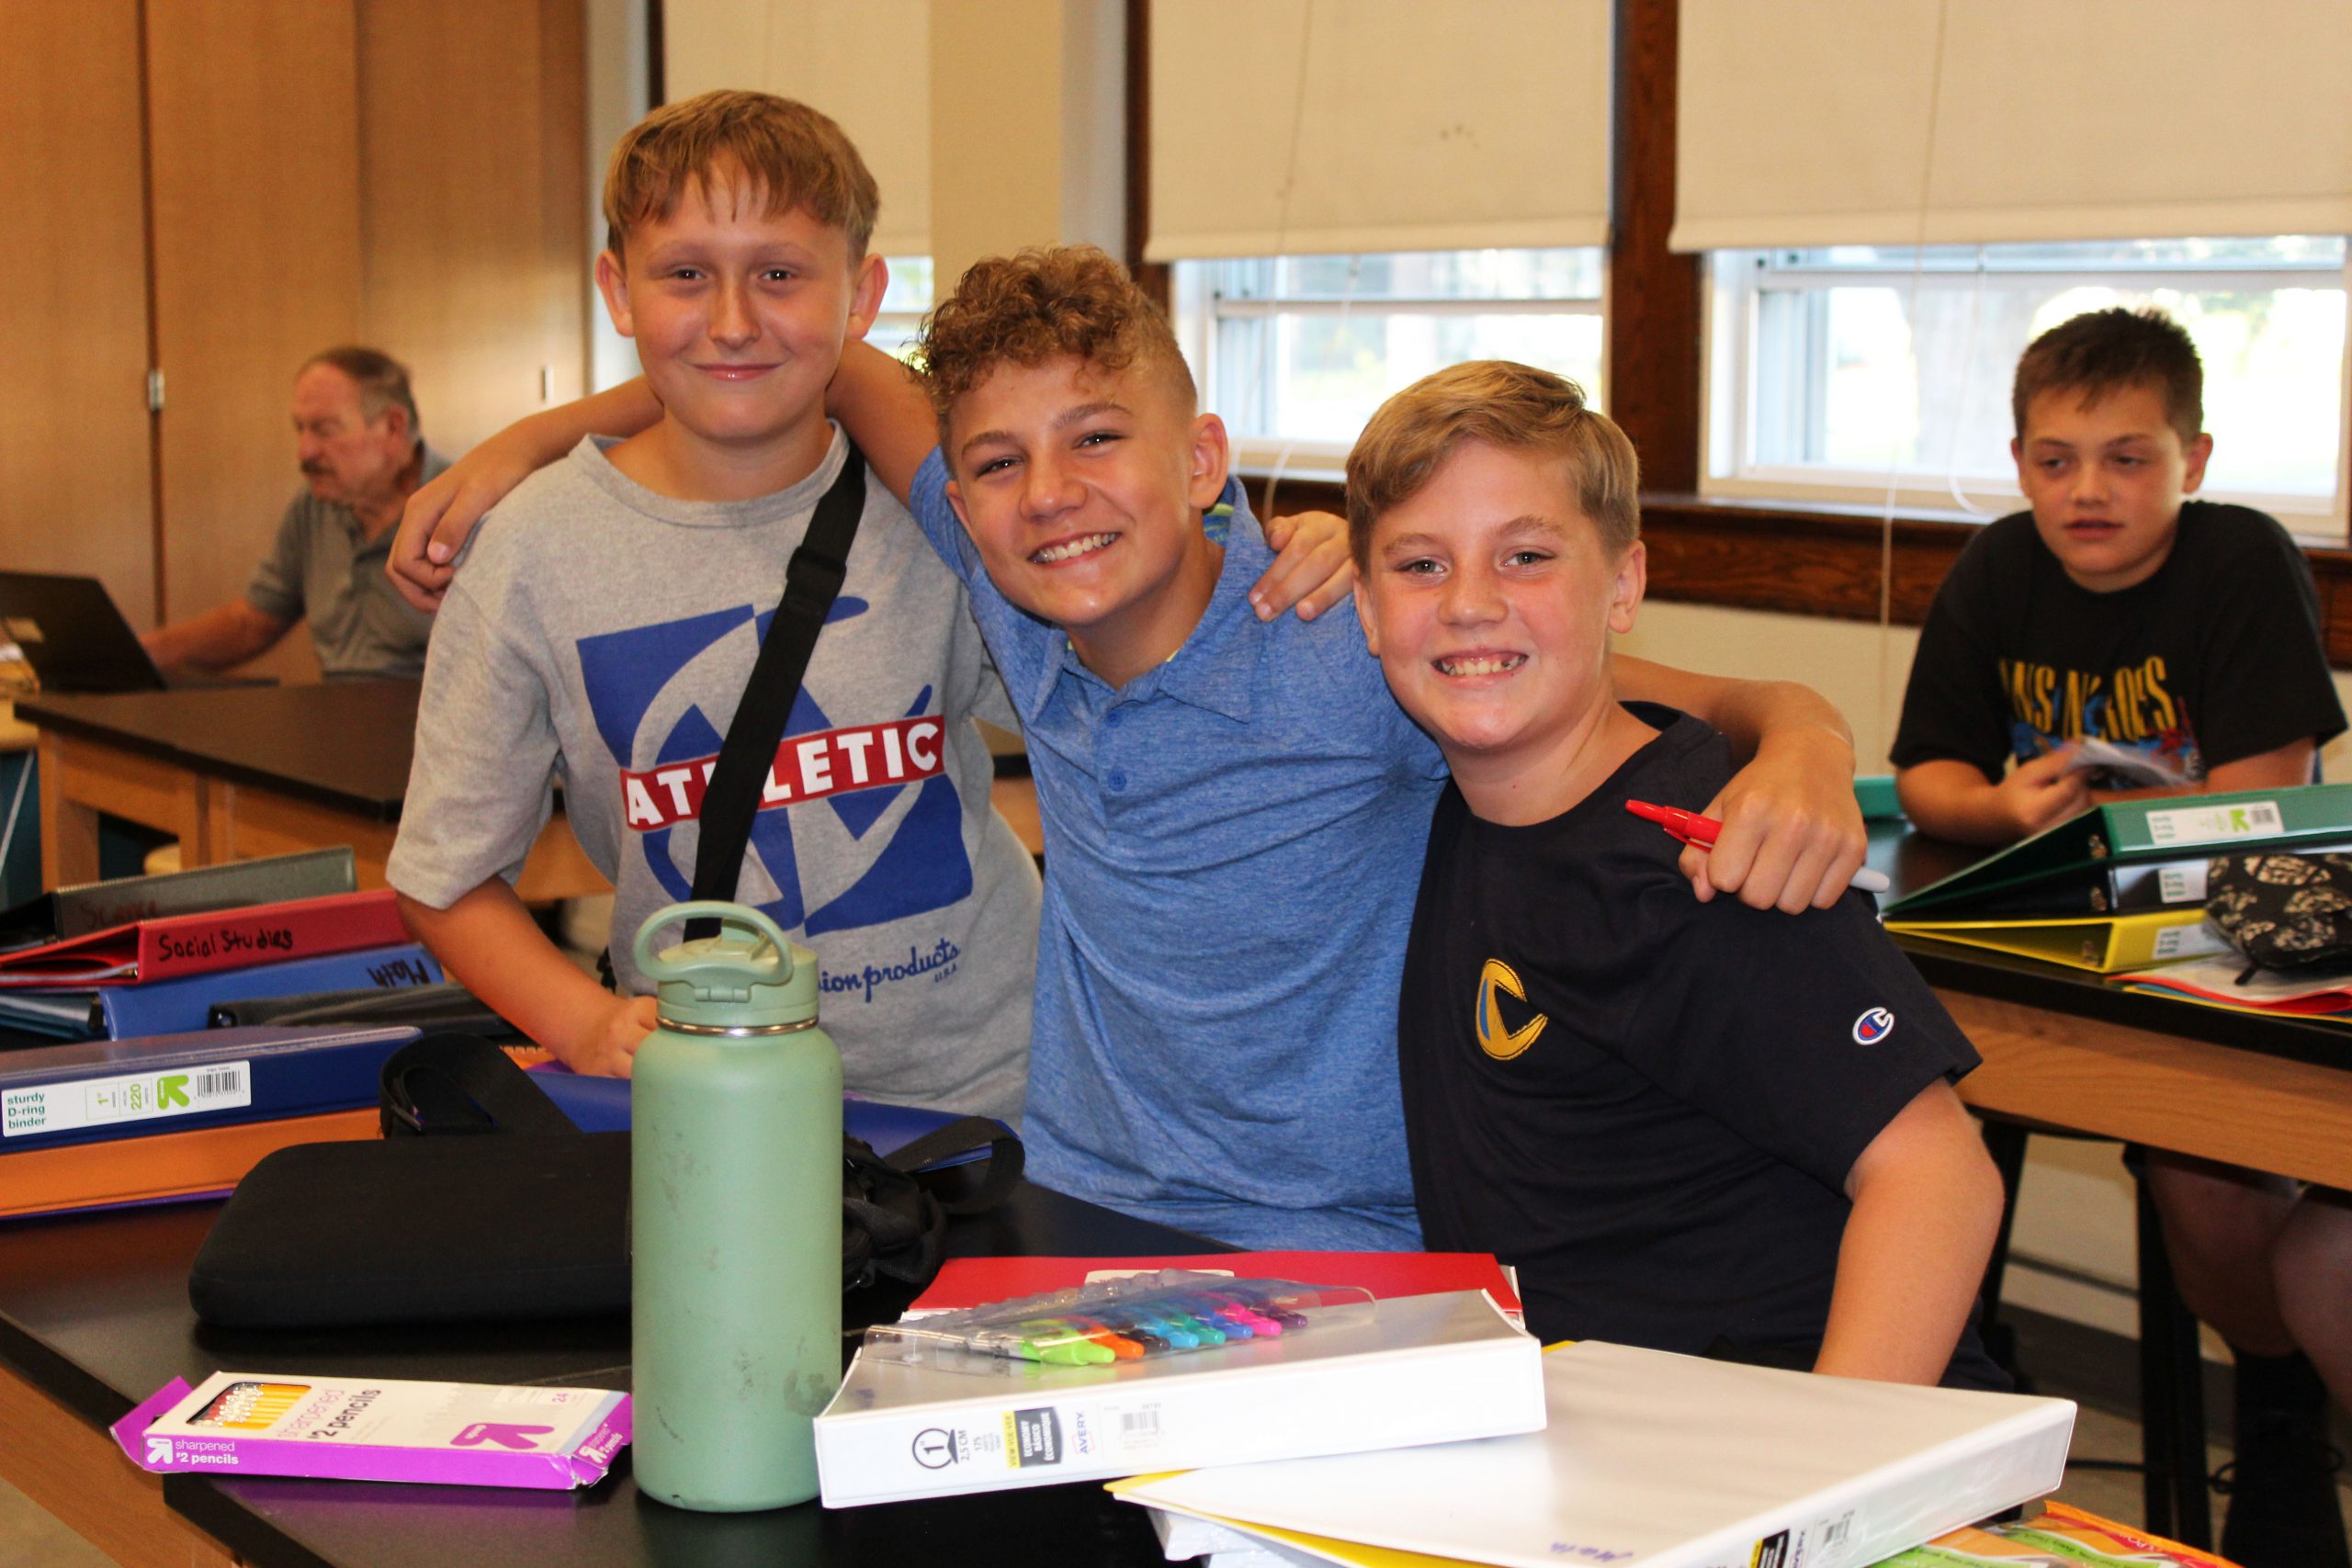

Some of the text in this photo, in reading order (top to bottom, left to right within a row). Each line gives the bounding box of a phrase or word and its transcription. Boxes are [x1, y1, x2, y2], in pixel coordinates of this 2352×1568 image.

[627, 722, 939, 825] ATLETIC
[158, 928, 293, 962] Social Studies
[863, 937, 960, 1003] products
[7, 1092, 44, 1105] sturdy
[8, 1105, 45, 1117] D-ring
[130, 1083, 142, 1111] 220
[8, 1117, 46, 1129] binder
[327, 1389, 382, 1429] pencils
[175, 1439, 235, 1453] sharpened
[957, 1429, 969, 1446] CM
[1020, 1420, 1034, 1458] ECONOMY
[1076, 1411, 1088, 1454] AVERY
[191, 1453, 239, 1465] pencils
